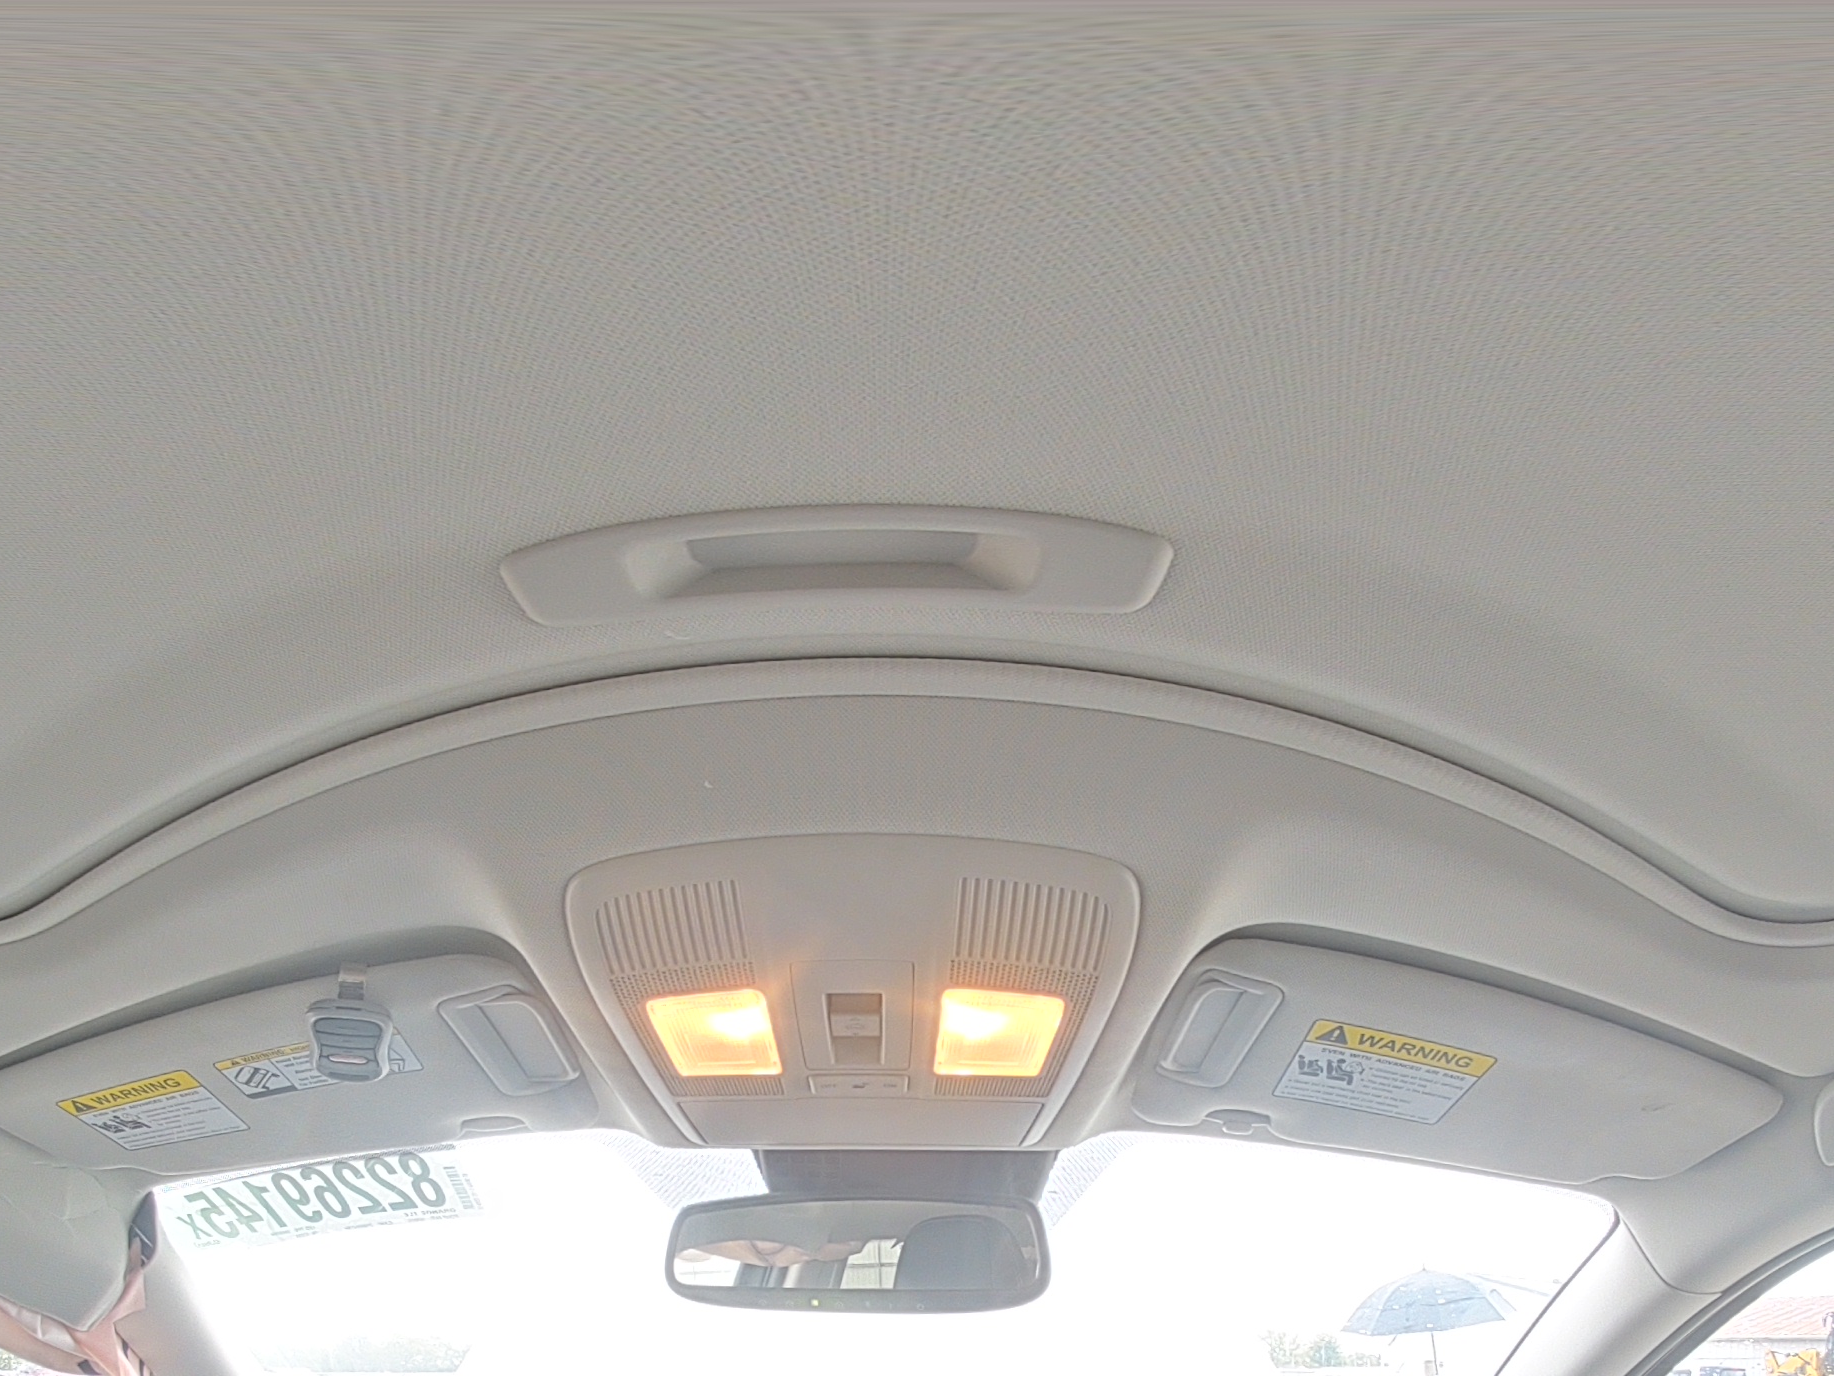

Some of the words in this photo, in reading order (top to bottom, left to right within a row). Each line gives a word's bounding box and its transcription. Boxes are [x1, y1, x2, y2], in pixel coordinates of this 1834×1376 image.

[1321, 1047, 1346, 1056] EVEN
[1376, 1058, 1422, 1072] ADVANCED
[1358, 1033, 1474, 1068] WARNING
[90, 1077, 181, 1106] WARNING
